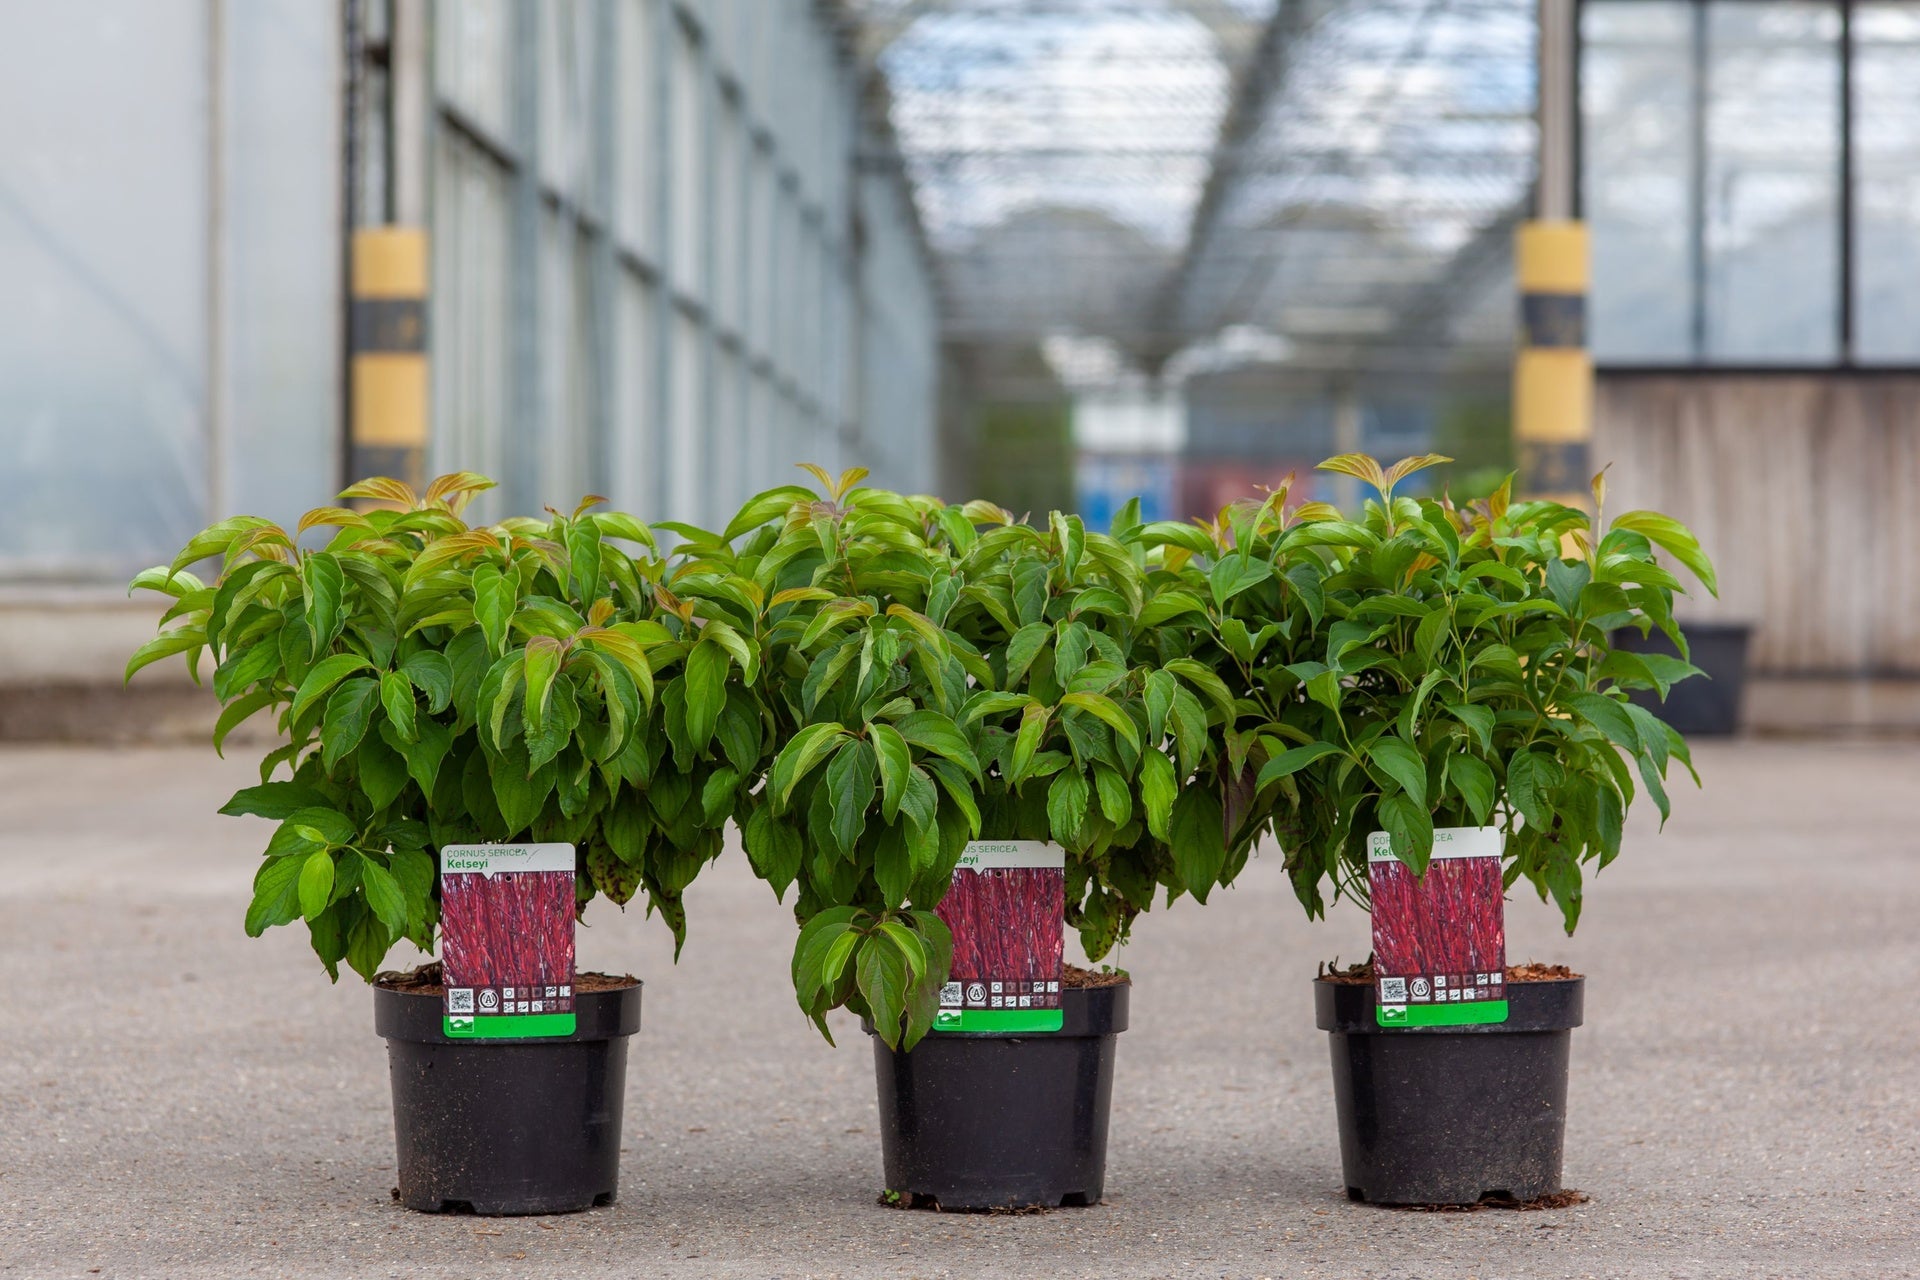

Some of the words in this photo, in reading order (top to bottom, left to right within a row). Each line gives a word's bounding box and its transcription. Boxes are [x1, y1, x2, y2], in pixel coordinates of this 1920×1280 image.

[447, 849, 486, 858] CORNUS
[488, 848, 528, 857] SERICEA
[979, 845, 1018, 853] SERICEA
[447, 859, 488, 869] Kelseyi
